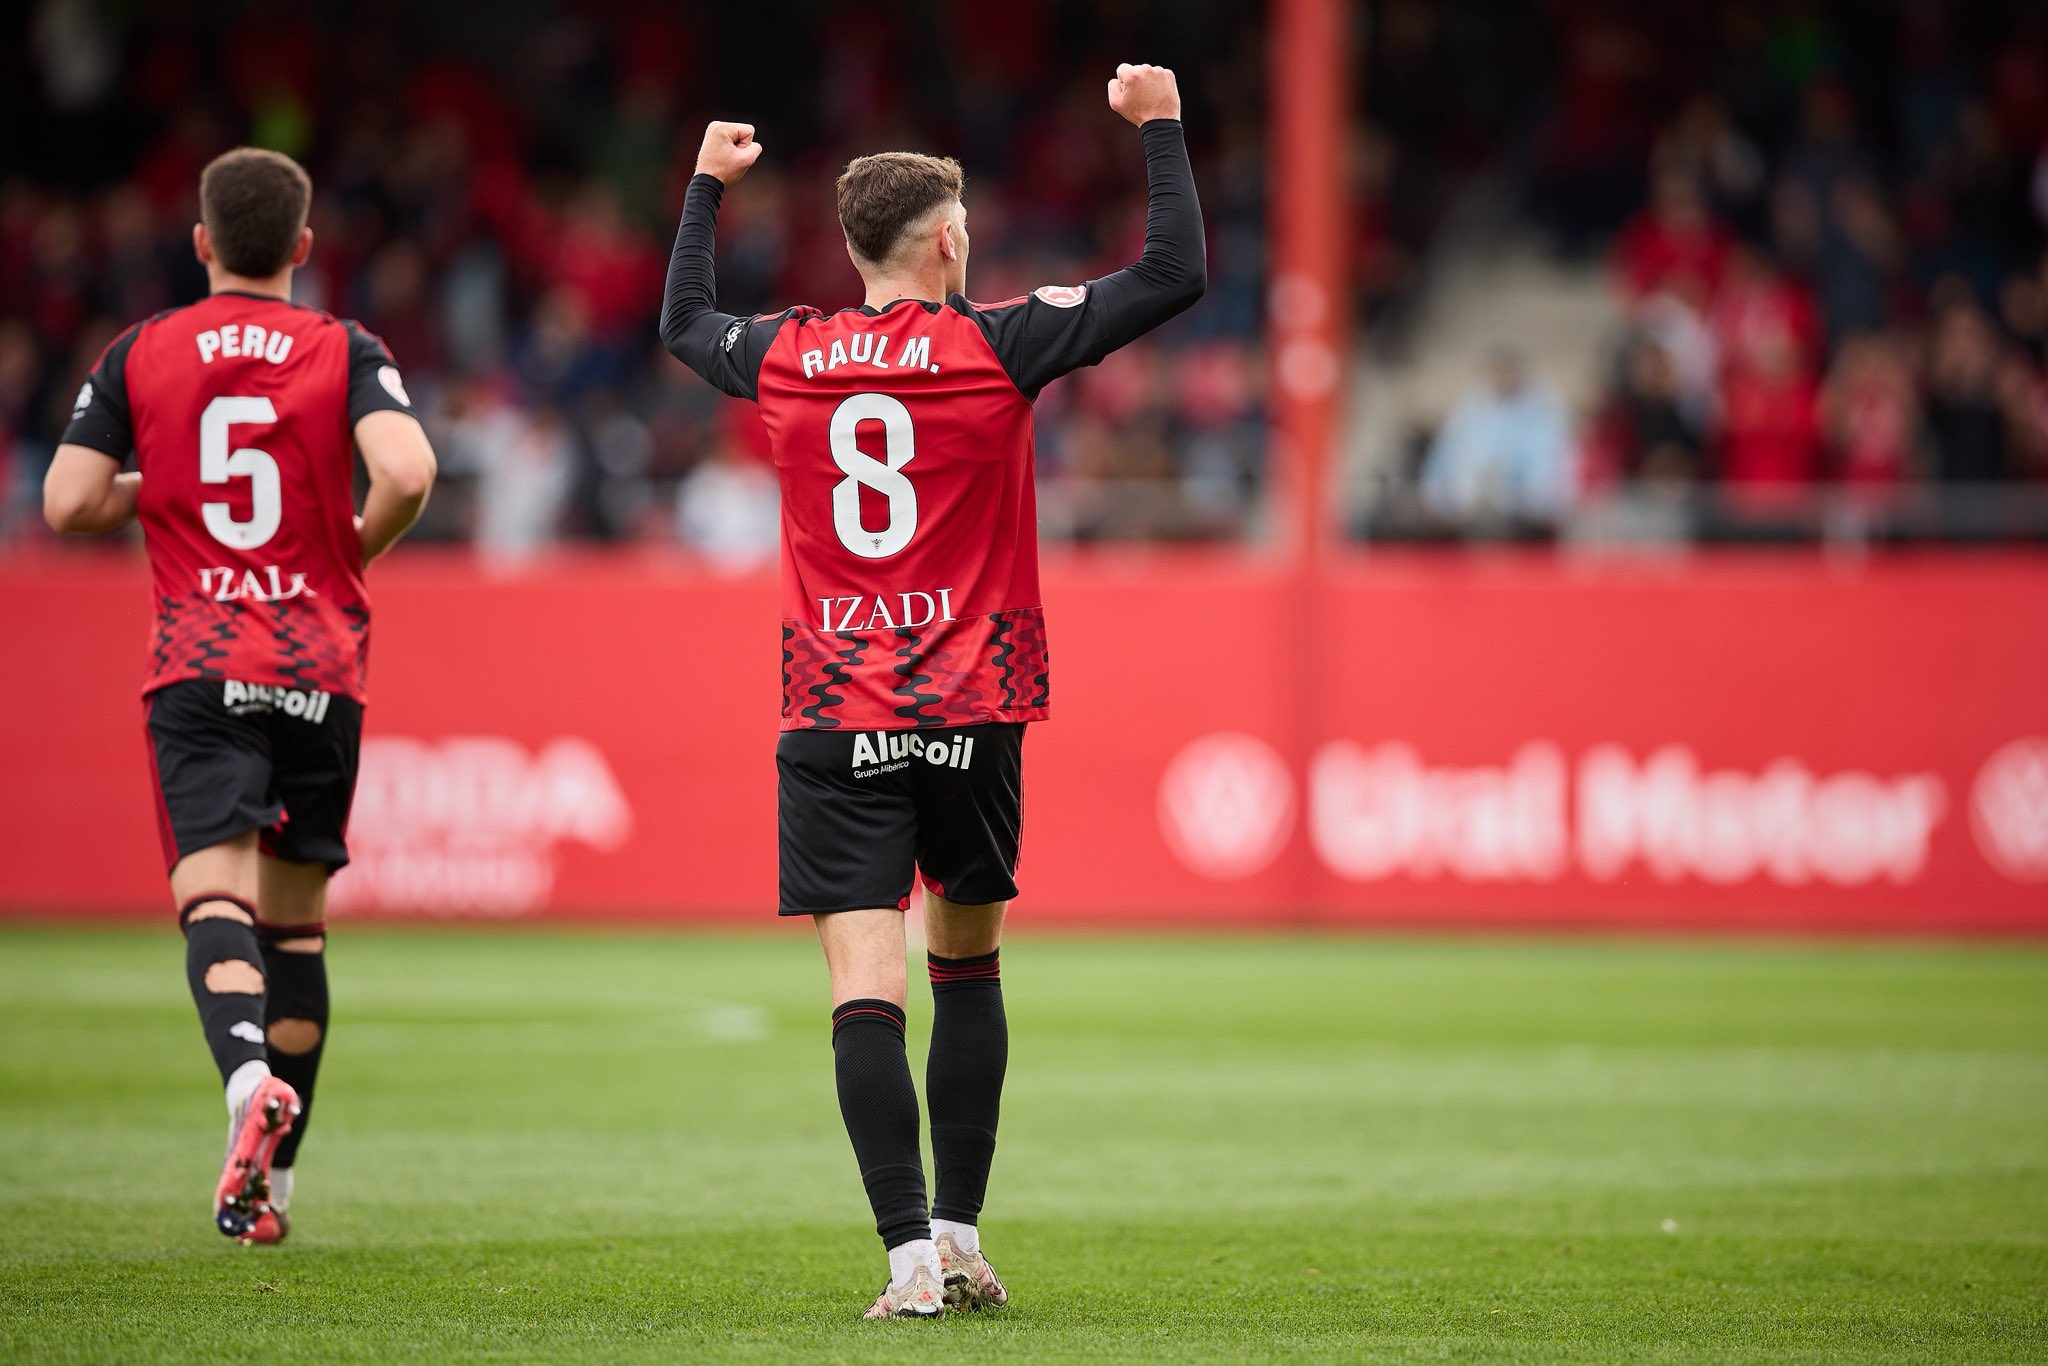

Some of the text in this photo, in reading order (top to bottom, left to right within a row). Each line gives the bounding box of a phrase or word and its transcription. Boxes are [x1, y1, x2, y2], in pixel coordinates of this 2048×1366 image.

[196, 324, 294, 365] PERU
[801, 333, 940, 379] RAUL M.
[200, 396, 282, 550] 5
[829, 392, 918, 559] 8
[817, 588, 956, 633] IZADI
[851, 731, 974, 770] Alucoil
[853, 768, 880, 779] Grupo
